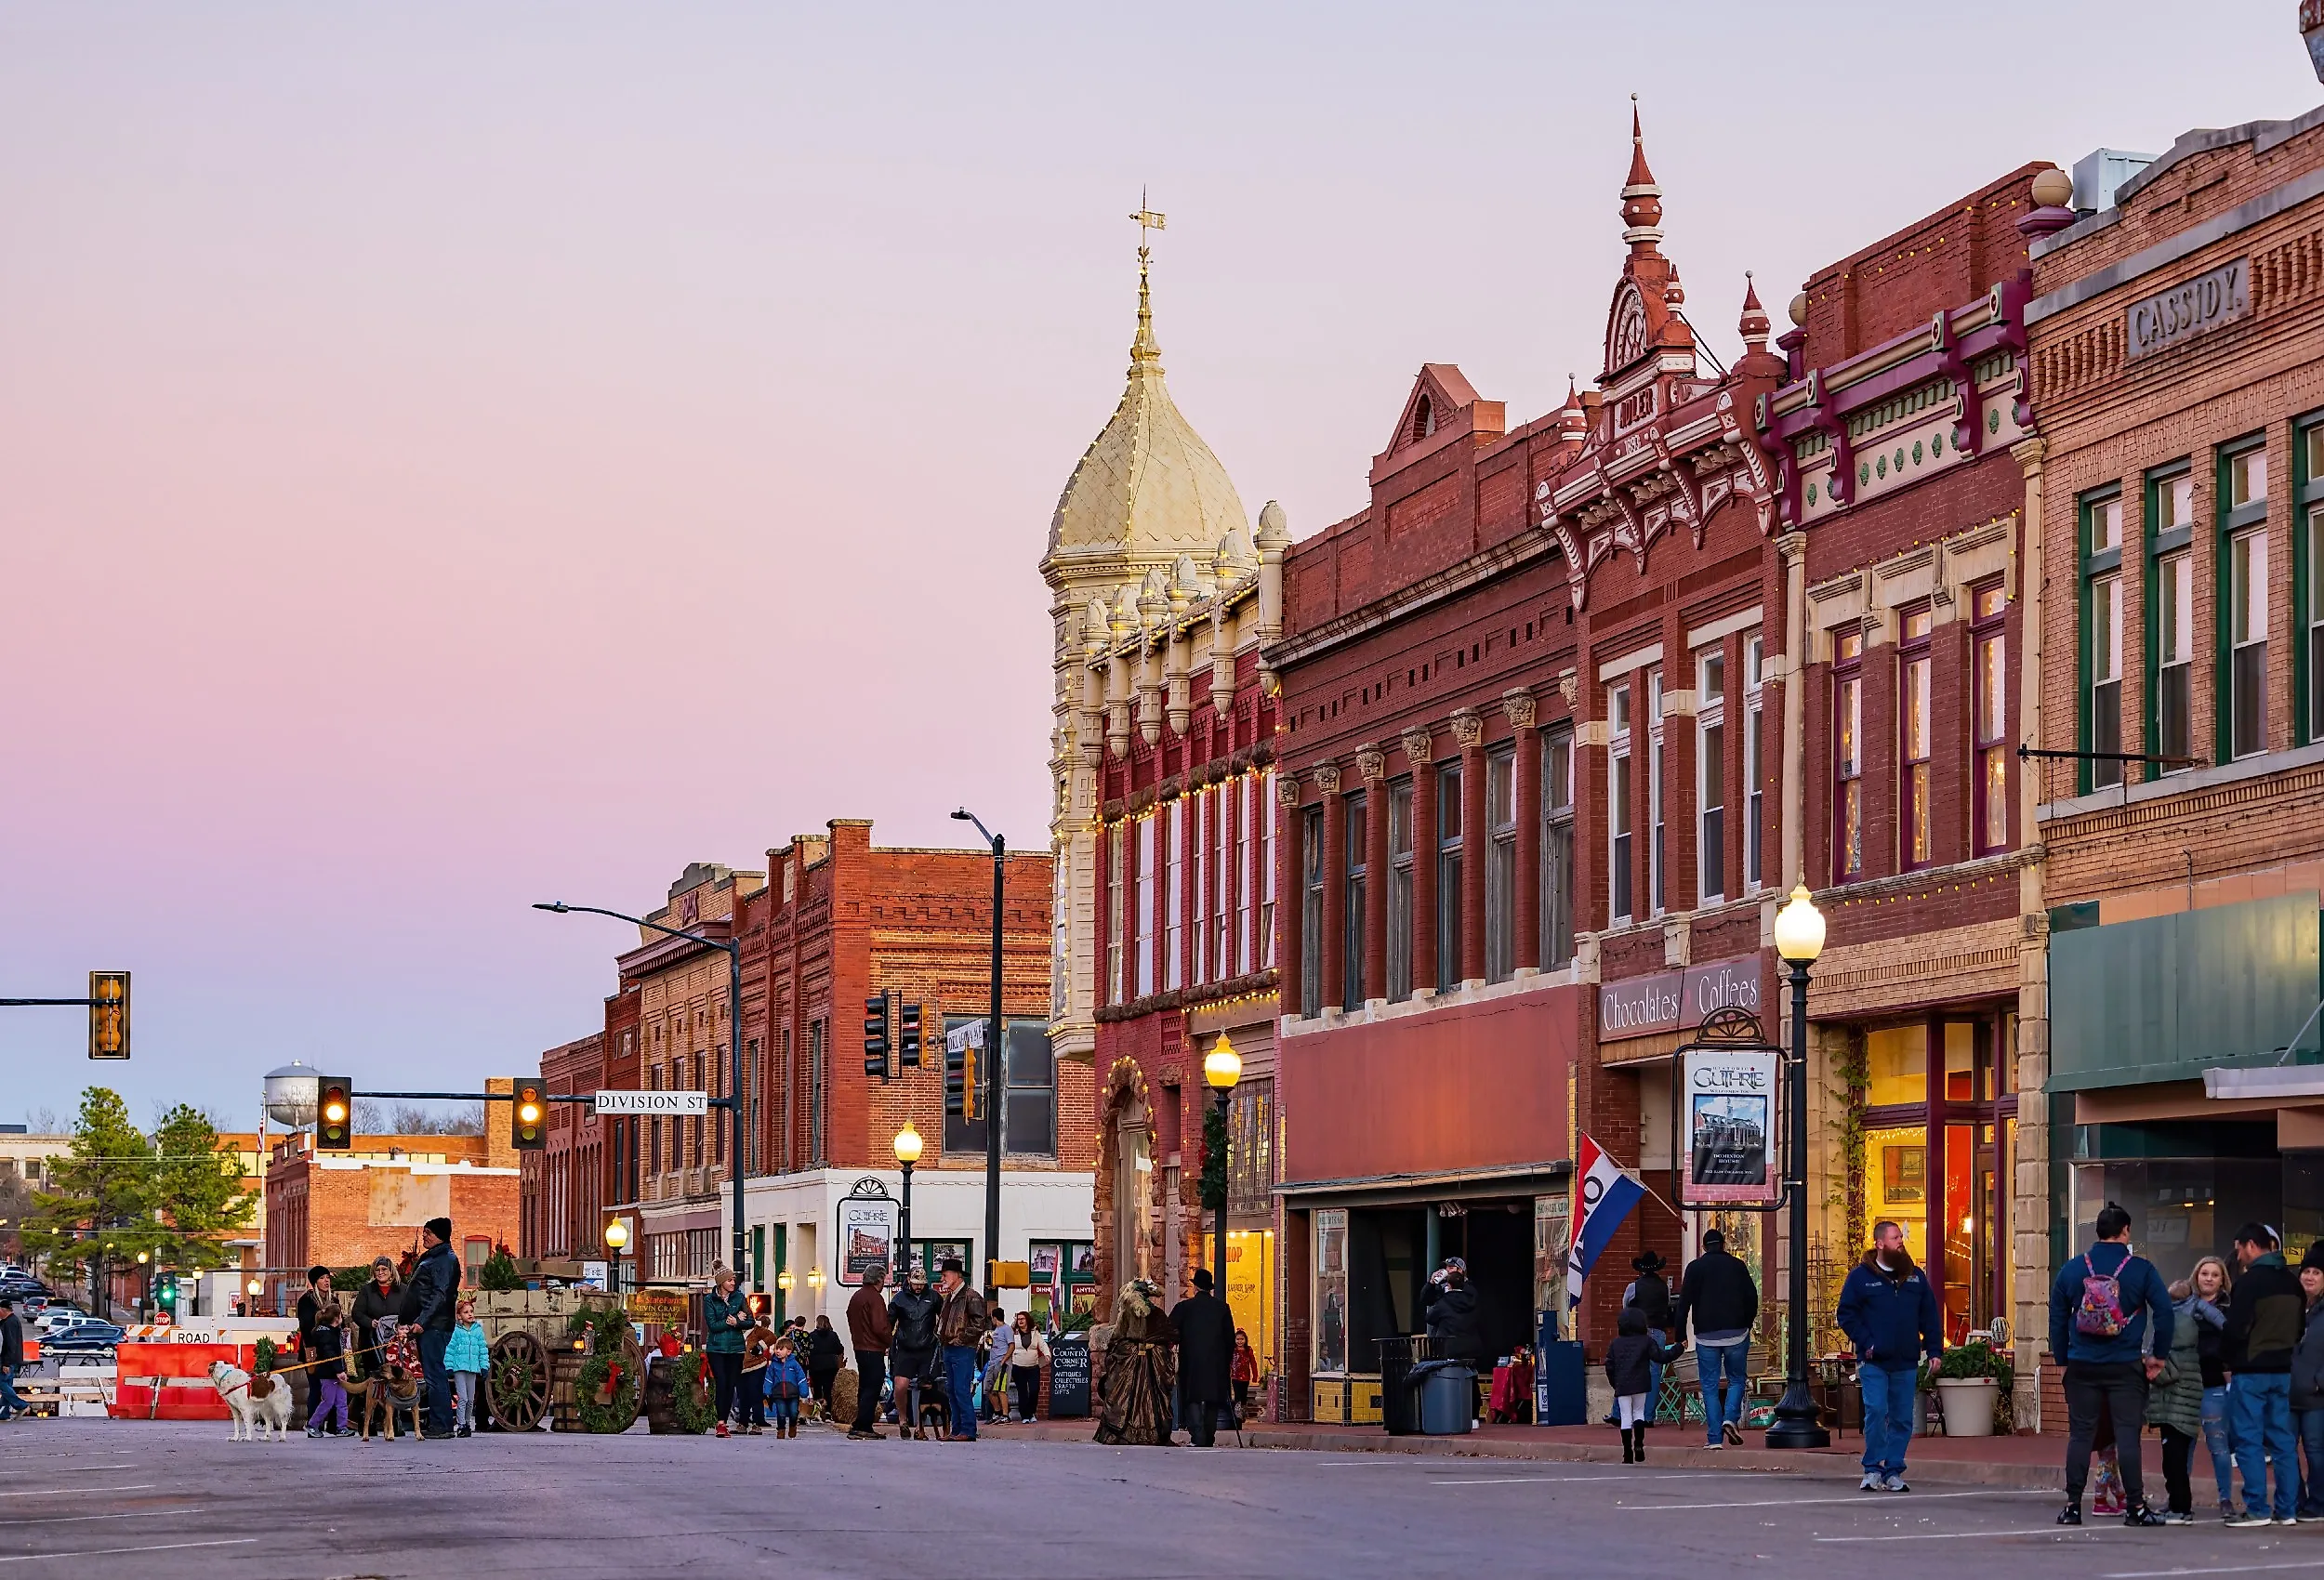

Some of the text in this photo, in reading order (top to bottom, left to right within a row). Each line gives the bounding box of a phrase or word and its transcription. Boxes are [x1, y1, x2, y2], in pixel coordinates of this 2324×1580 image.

[2135, 267, 2242, 347] CASSIDY.
[1619, 388, 1653, 429] ADLER
[1604, 968, 1757, 1031] Chocolates Coffees
[1693, 1067, 1766, 1090] GUTHRIE
[598, 1095, 706, 1109] DIVISION ST
[849, 1209, 889, 1222] GUTHRIE
[178, 1333, 210, 1344] ROAD
[1052, 1347, 1089, 1357] COUNTRY
[1053, 1358, 1088, 1368] CORNER
